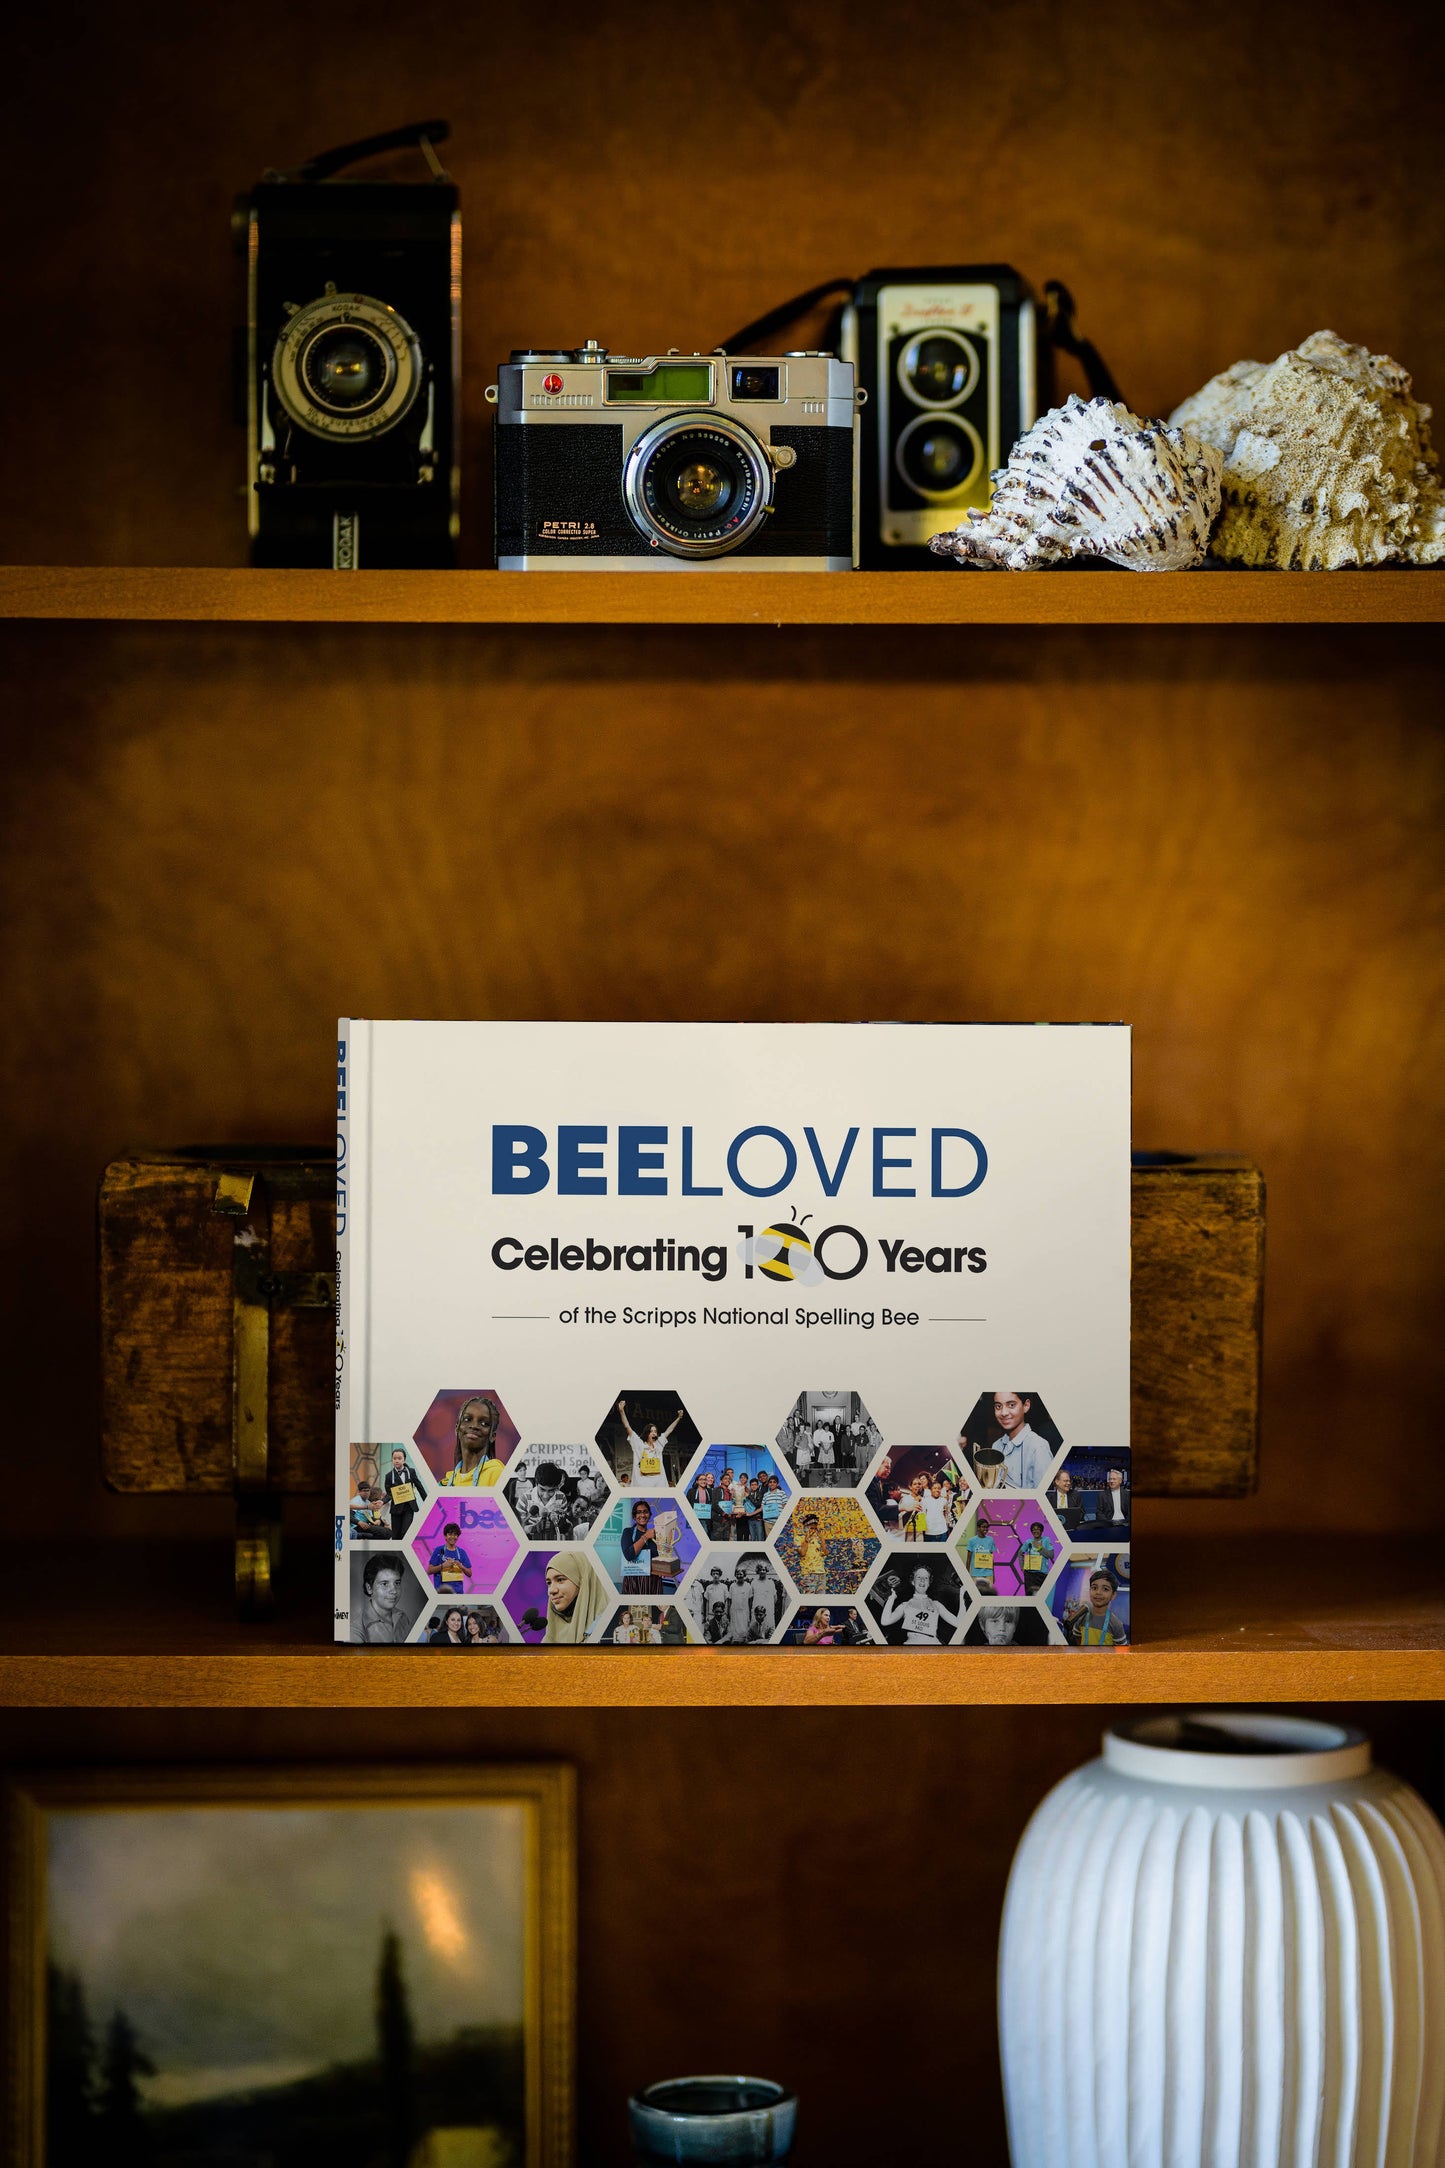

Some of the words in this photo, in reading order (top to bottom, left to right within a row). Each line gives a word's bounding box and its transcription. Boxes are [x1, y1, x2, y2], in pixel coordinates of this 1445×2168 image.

[339, 516, 352, 568] KODAK
[543, 521, 581, 529] PETRI
[584, 522, 595, 530] 2.8
[492, 1125, 988, 1198] BEELOVED
[492, 1237, 728, 1282] Celebrating
[878, 1239, 988, 1274] Years
[559, 1307, 580, 1324] of
[584, 1307, 617, 1324] the
[622, 1307, 697, 1328] Scripps
[703, 1307, 789, 1325] National
[795, 1308, 875, 1330] Spelling
[881, 1309, 920, 1326] Bee
[335, 1515, 345, 1551] bee
[915, 1611, 929, 1622] 49
